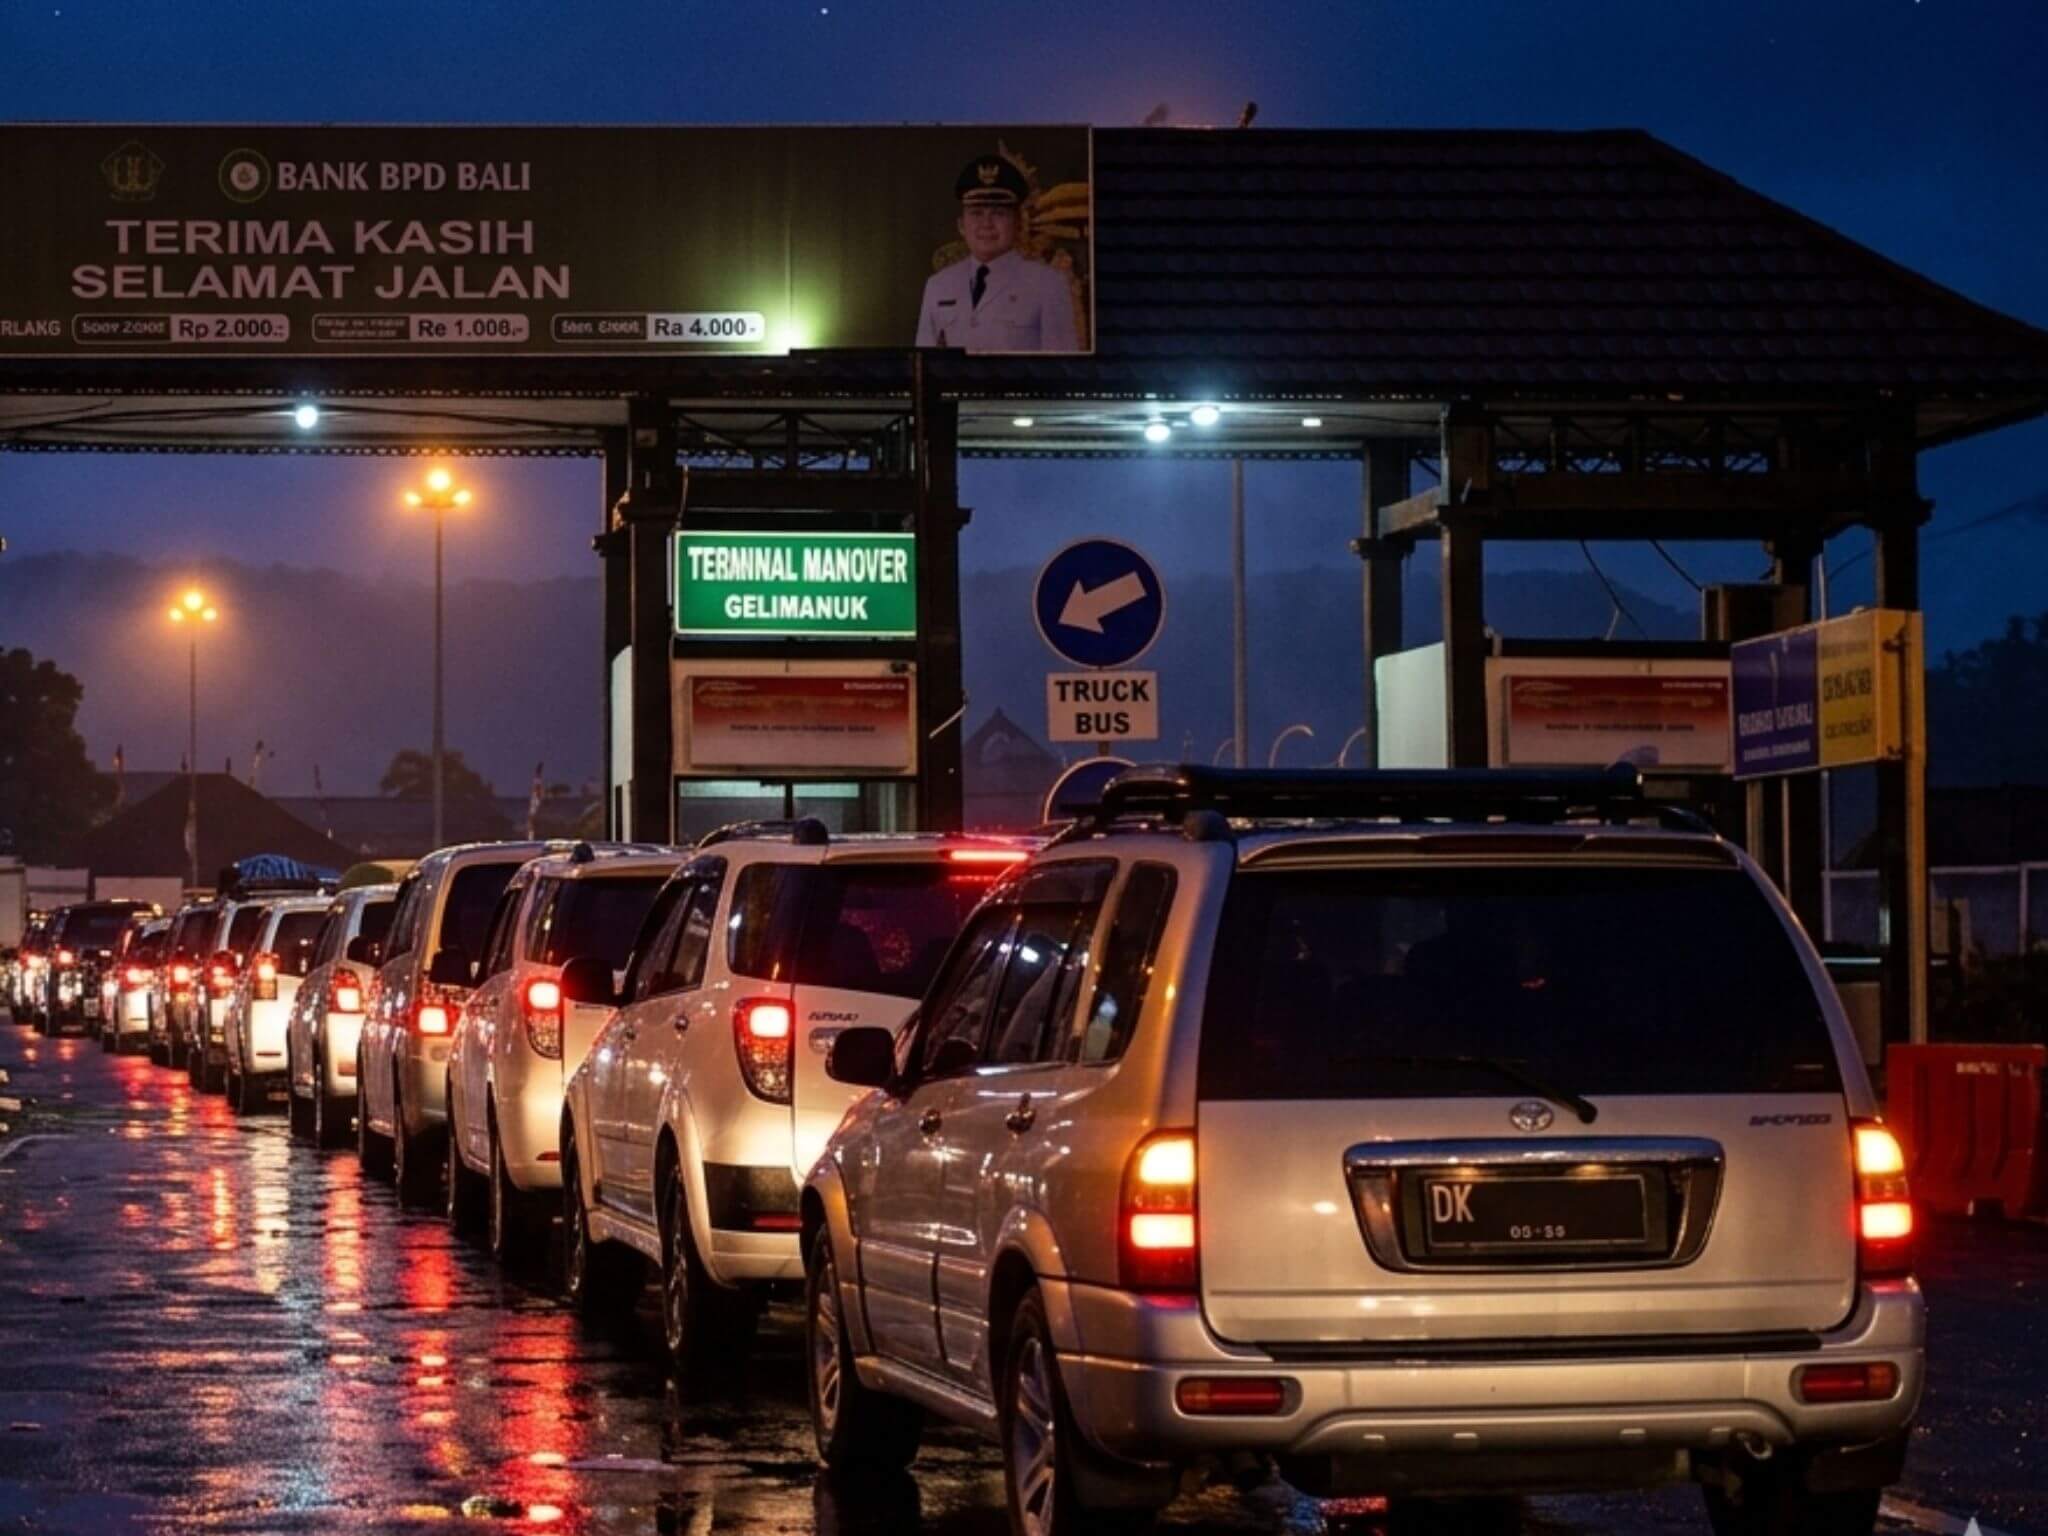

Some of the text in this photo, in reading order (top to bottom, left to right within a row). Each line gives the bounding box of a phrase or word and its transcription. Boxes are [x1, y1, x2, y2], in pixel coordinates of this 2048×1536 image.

[277, 161, 531, 191] BANK BPD BALI
[105, 219, 534, 254] TERIMA KASIH
[71, 263, 570, 299] SELAMAT JALAN
[179, 318, 209, 339] Rp
[418, 318, 447, 337] Re
[654, 317, 683, 337] Ra
[804, 547, 908, 584] MANOVER
[724, 594, 869, 621] GELIMANUK
[1054, 679, 1150, 702] TRUCK
[1075, 711, 1130, 735] BUS
[1431, 1183, 1475, 1223] DK
